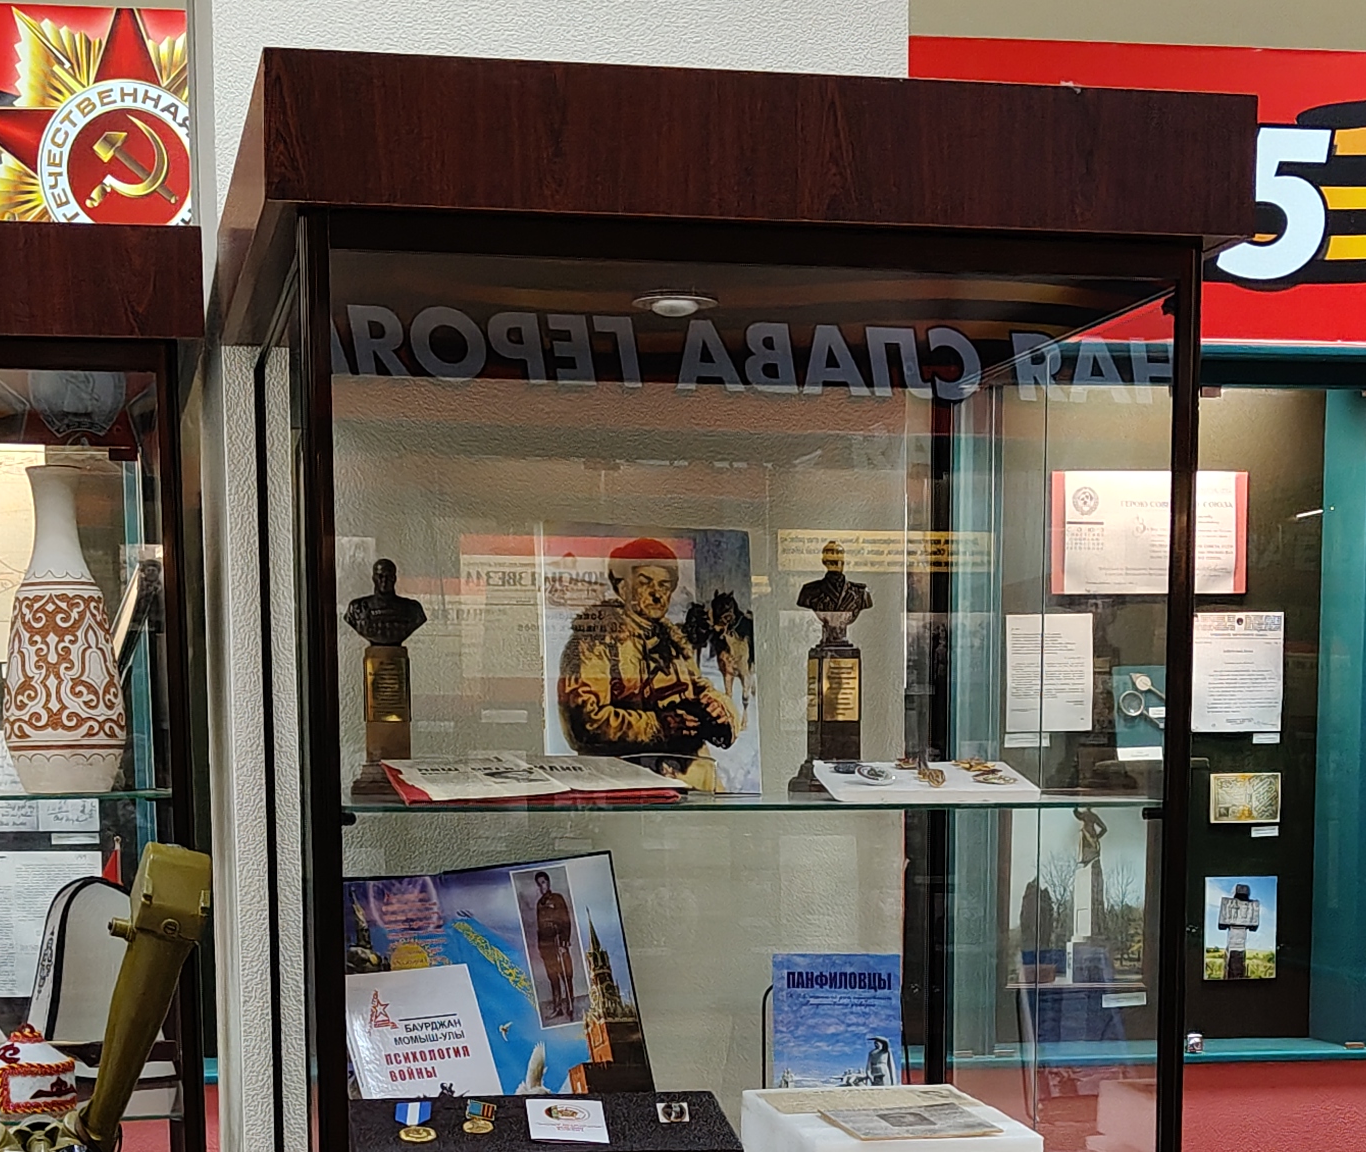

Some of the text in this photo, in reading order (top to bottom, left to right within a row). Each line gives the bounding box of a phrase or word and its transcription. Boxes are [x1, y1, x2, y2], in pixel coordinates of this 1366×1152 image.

[46, 86, 190, 222] ТЕЧЕСТВЕННАЯ
[786, 971, 892, 992] ПАНФИЛОВЦЫ
[404, 1018, 462, 1033] БАУРДЖАН
[393, 1030, 466, 1046] МОМЫШ-УЛЫ
[384, 1045, 471, 1066] ПСИХОЛОГИЯ
[389, 1066, 438, 1082] ВОЙНЫ
